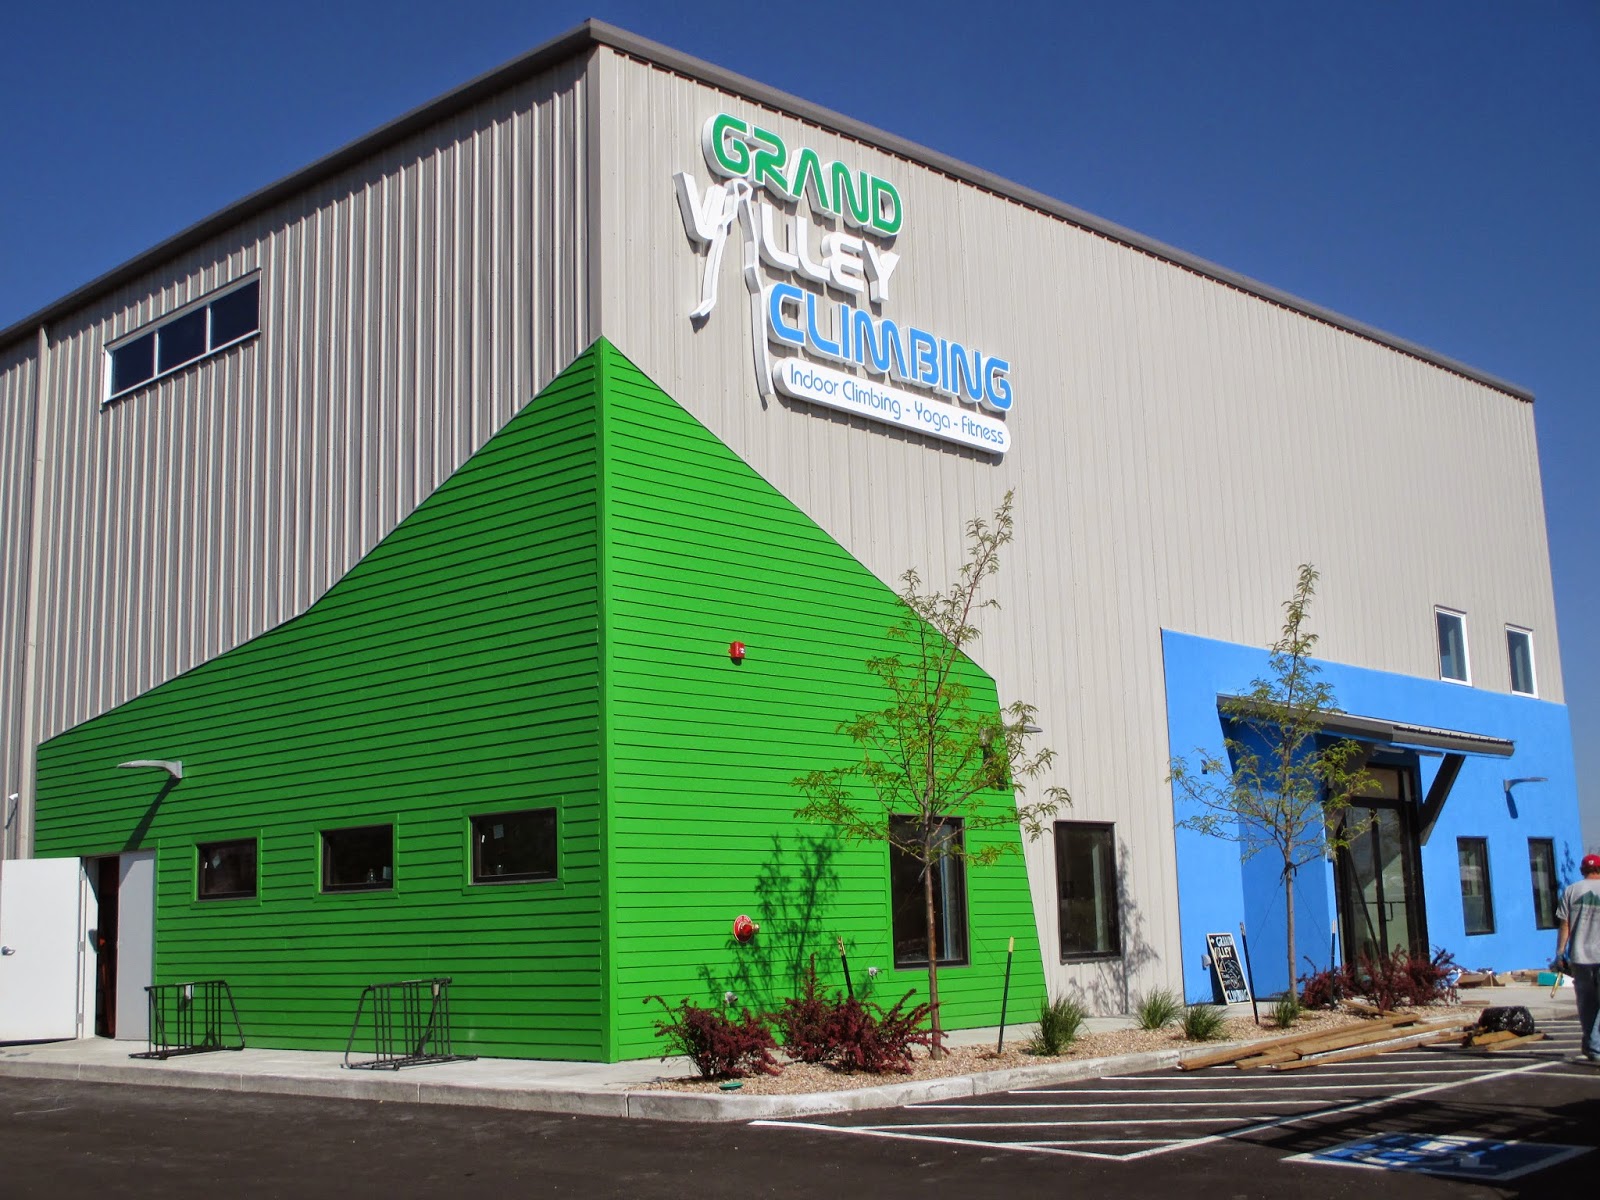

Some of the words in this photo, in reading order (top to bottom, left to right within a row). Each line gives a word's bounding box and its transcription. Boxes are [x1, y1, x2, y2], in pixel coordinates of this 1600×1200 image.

[709, 113, 904, 236] GRAND
[767, 282, 1013, 412] CLIMBING
[790, 363, 839, 396] Indoor
[842, 380, 901, 420] Climbing
[914, 402, 950, 432] Yoga
